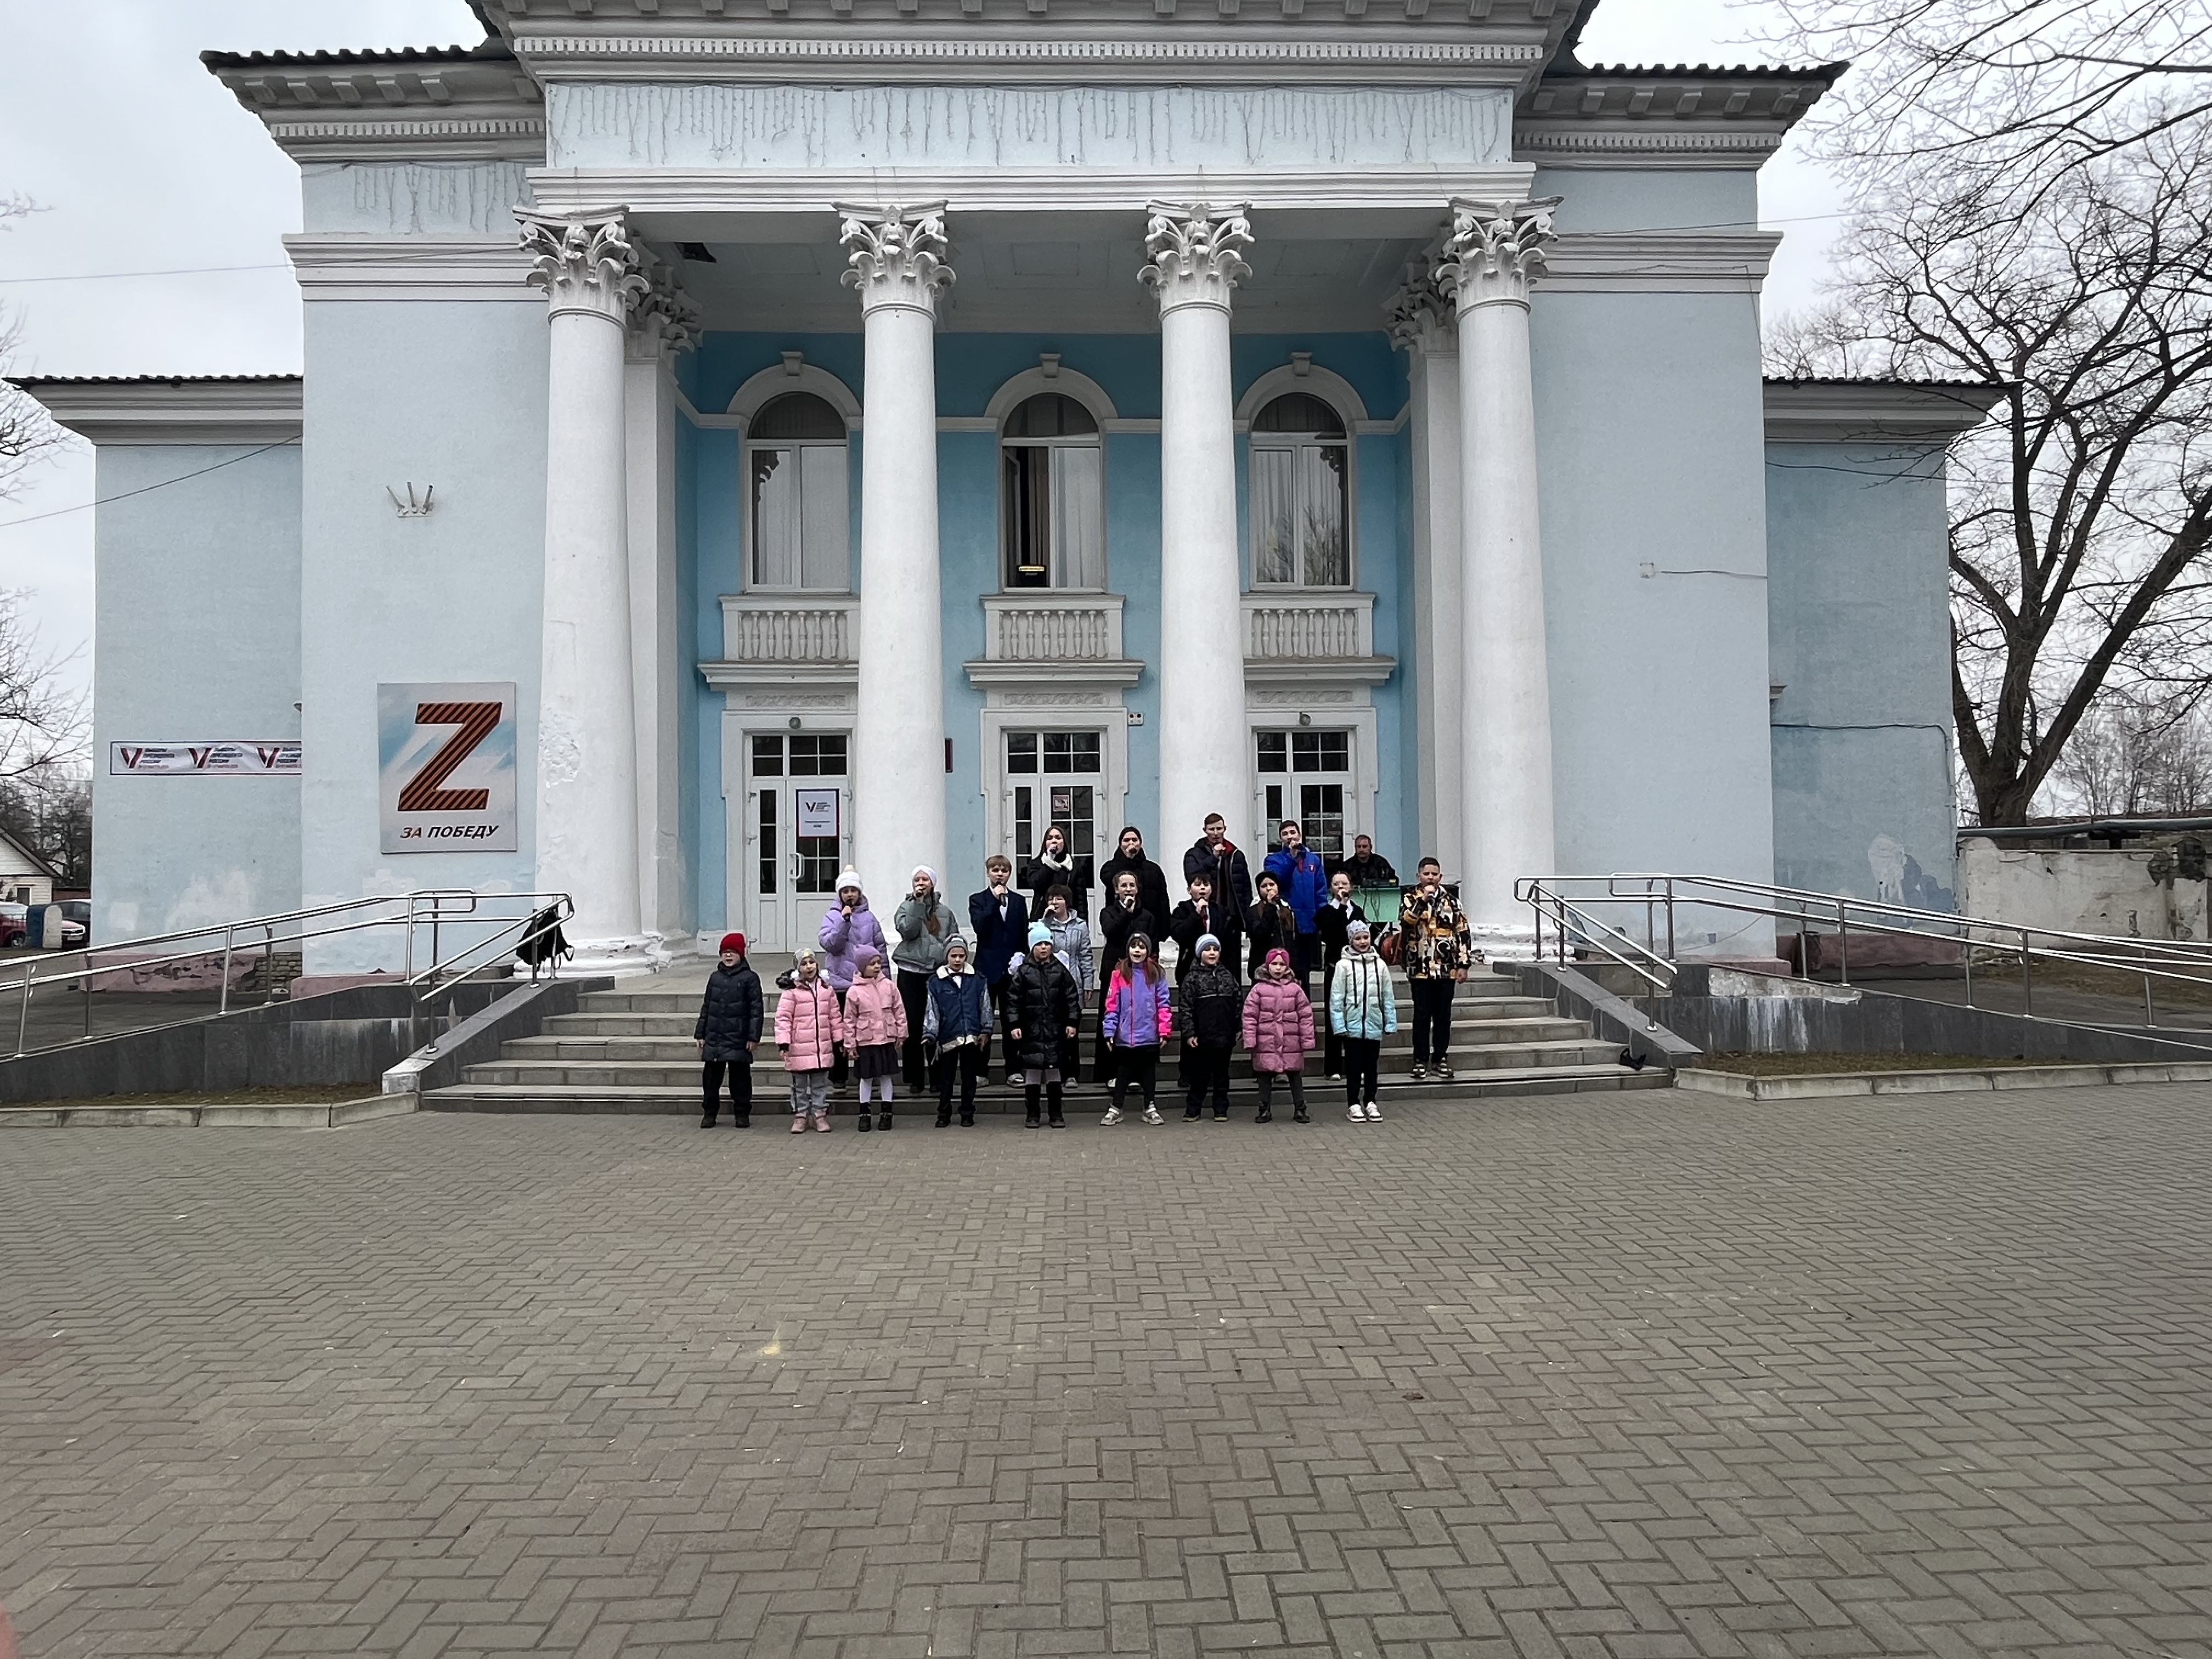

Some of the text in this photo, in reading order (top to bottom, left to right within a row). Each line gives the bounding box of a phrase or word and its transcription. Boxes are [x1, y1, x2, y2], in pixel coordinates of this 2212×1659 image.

[120, 747, 143, 769] V
[188, 747, 212, 768] V
[256, 747, 280, 768] V
[397, 702, 502, 811] Z
[805, 802, 816, 812] V
[400, 825, 499, 839] ЗА ПОБЕДУ
